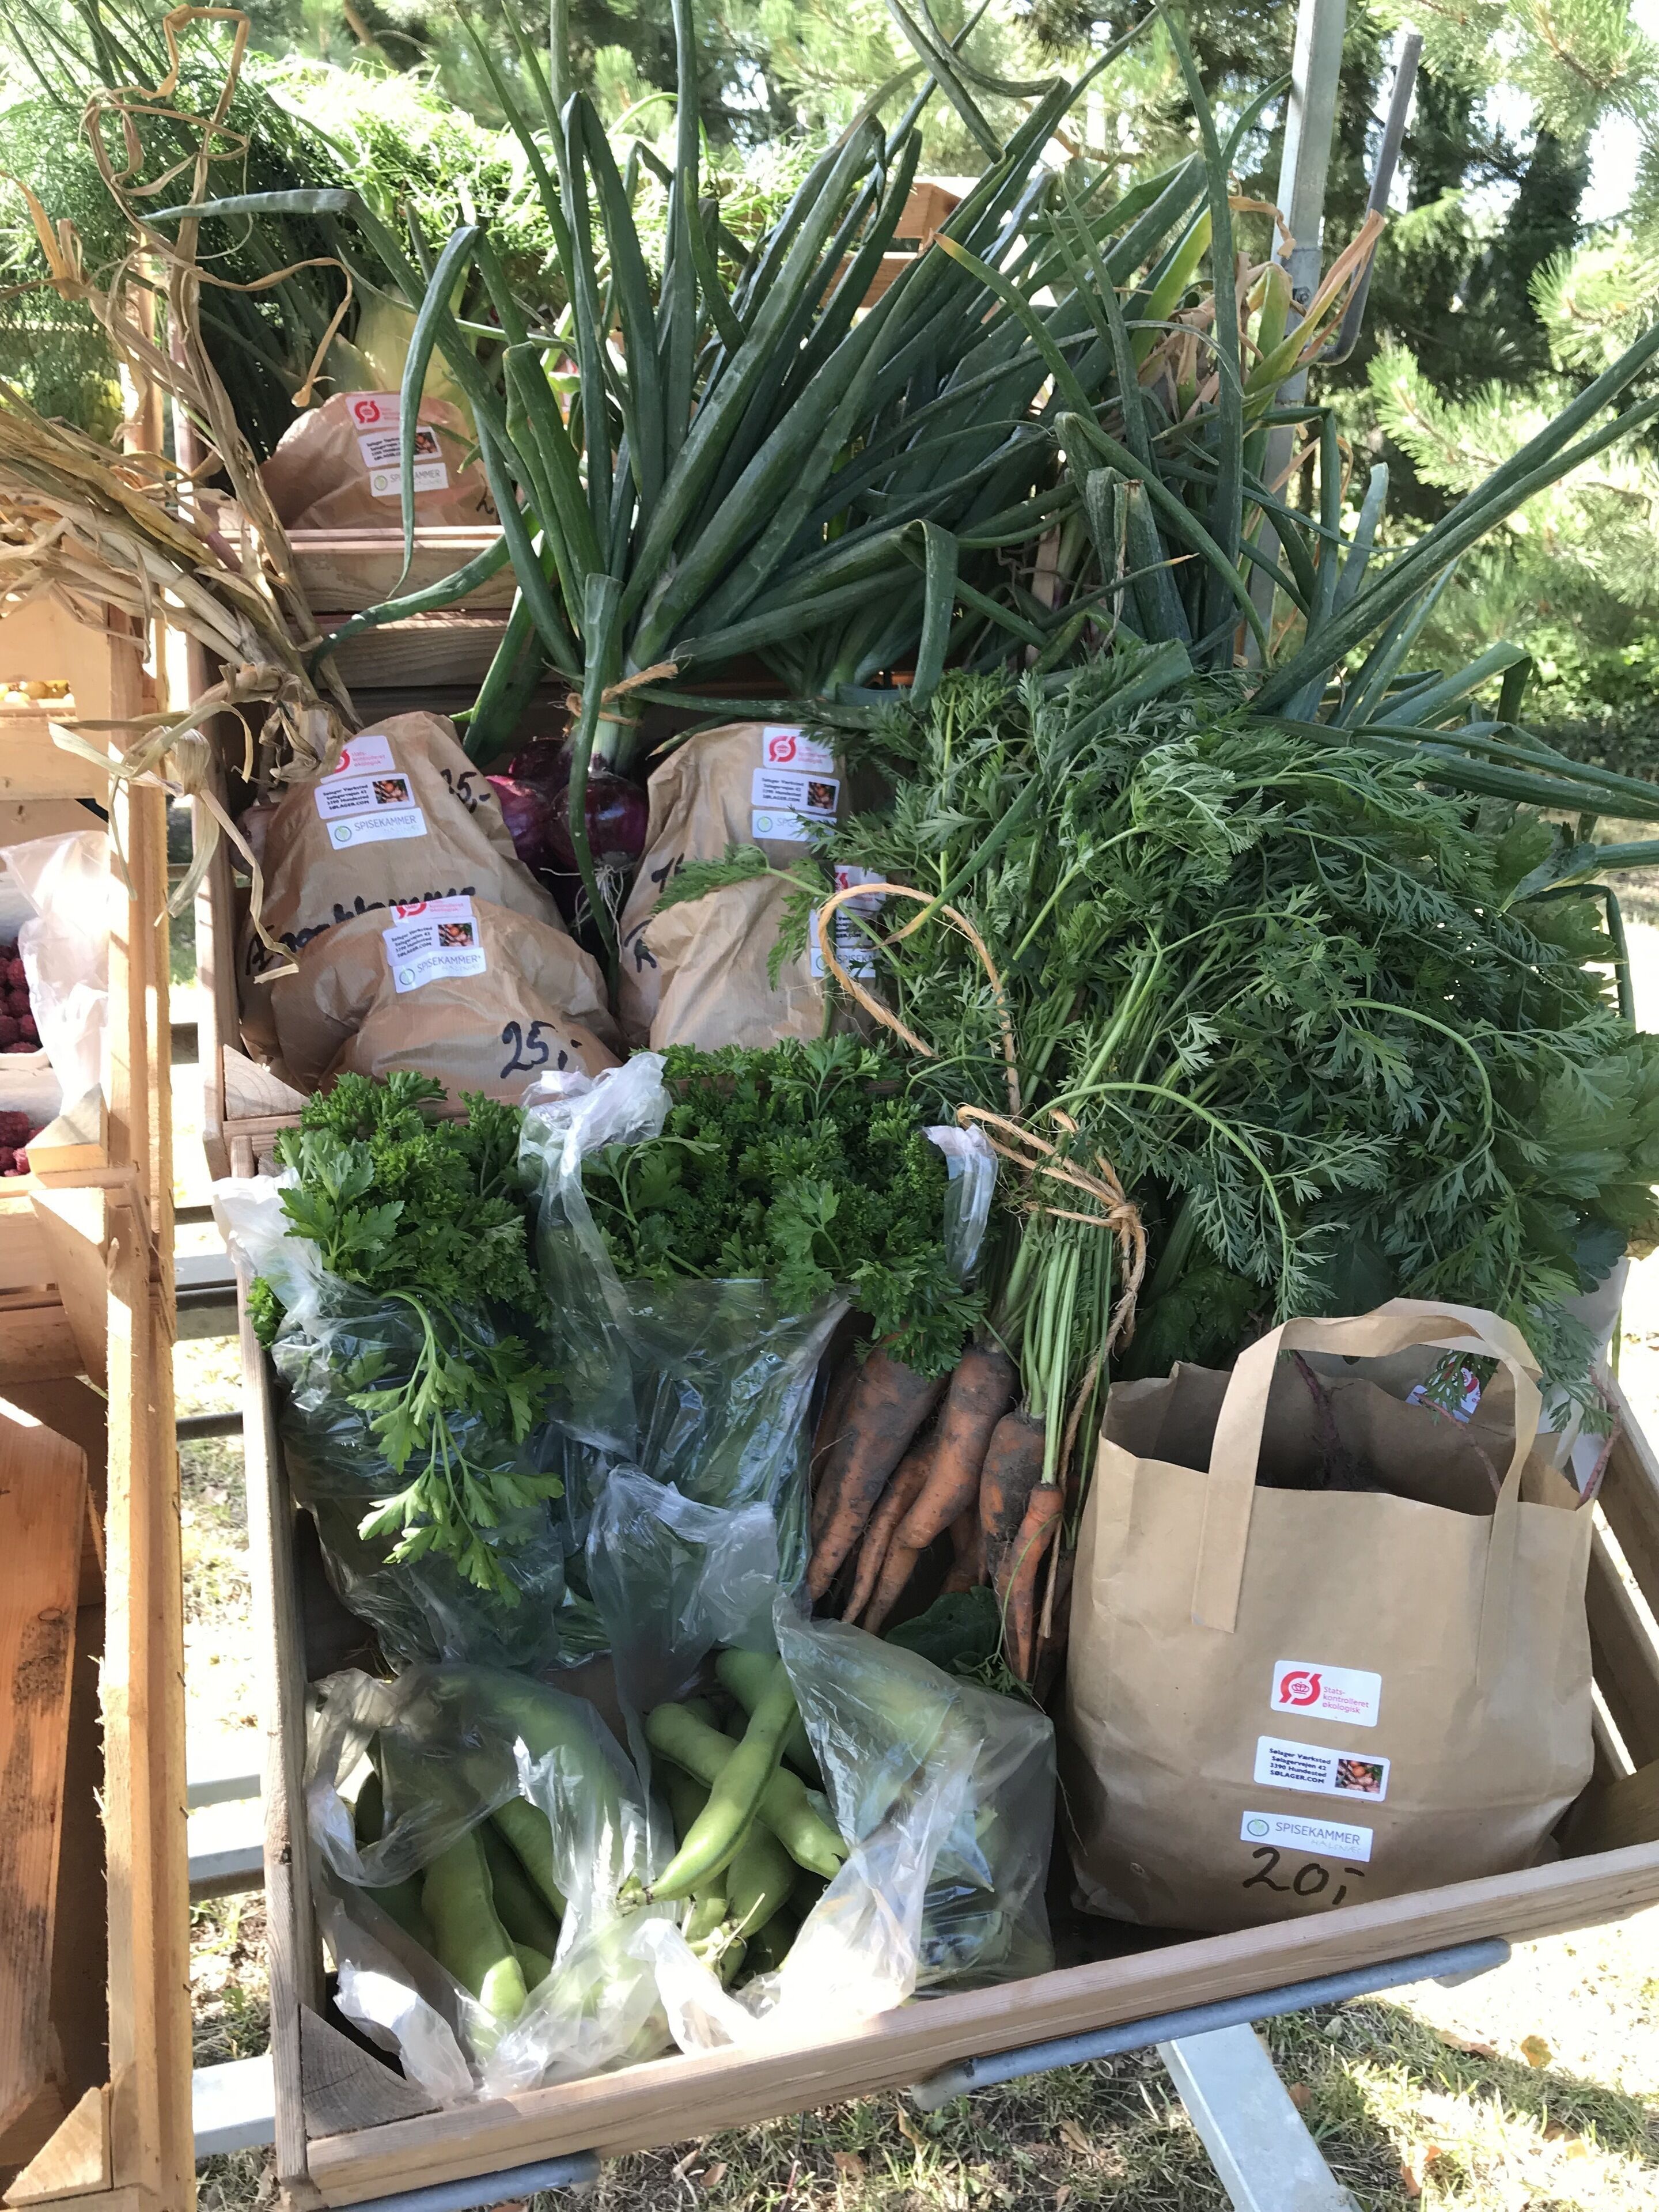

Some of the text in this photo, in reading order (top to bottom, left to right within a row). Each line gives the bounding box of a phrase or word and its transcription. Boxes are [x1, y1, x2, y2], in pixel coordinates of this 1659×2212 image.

[354, 815, 417, 831] SPISEKAMMER
[416, 955, 478, 973] SPISEKAMMER
[499, 1020, 583, 1079] 25,-
[1323, 1686, 1346, 1695] Stats-
[1322, 1702, 1361, 1714] økologisk
[1323, 1693, 1369, 1708] kontrolleret
[1269, 1748, 1331, 1765] Sølager Værksted
[1271, 1755, 1316, 1770] Sølagervejen
[1270, 1762, 1327, 1778] 3390 Hundested
[1270, 1770, 1325, 1784] SØLAGER.COM
[1275, 1821, 1361, 1846] SPISEKAMMER
[1242, 1846, 1365, 1905] 20,-
